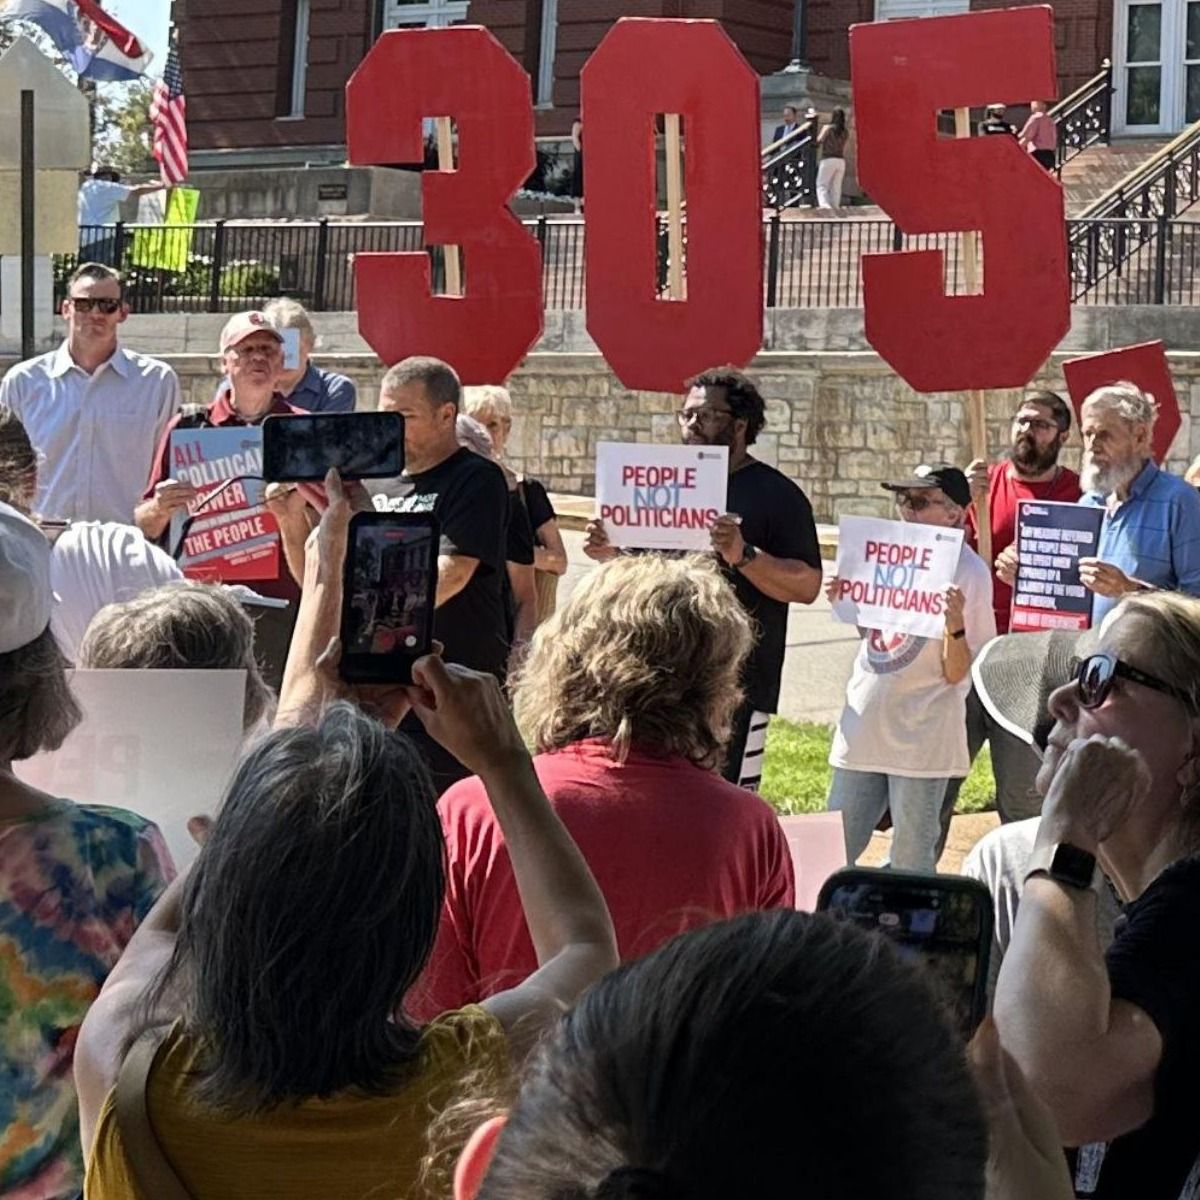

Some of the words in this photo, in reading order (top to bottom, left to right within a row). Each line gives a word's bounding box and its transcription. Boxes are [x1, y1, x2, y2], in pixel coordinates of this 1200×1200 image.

[174, 440, 205, 468] ALL
[622, 465, 697, 489] PEOPLE
[186, 481, 247, 517] POWER
[633, 483, 685, 512] NOT
[600, 504, 719, 529] POLITICIANS
[185, 532, 213, 556] THE
[212, 516, 266, 548] PEOPLE
[865, 540, 933, 570] PEOPLE
[872, 563, 921, 590] NOT
[838, 579, 943, 615] POLITICIANS
